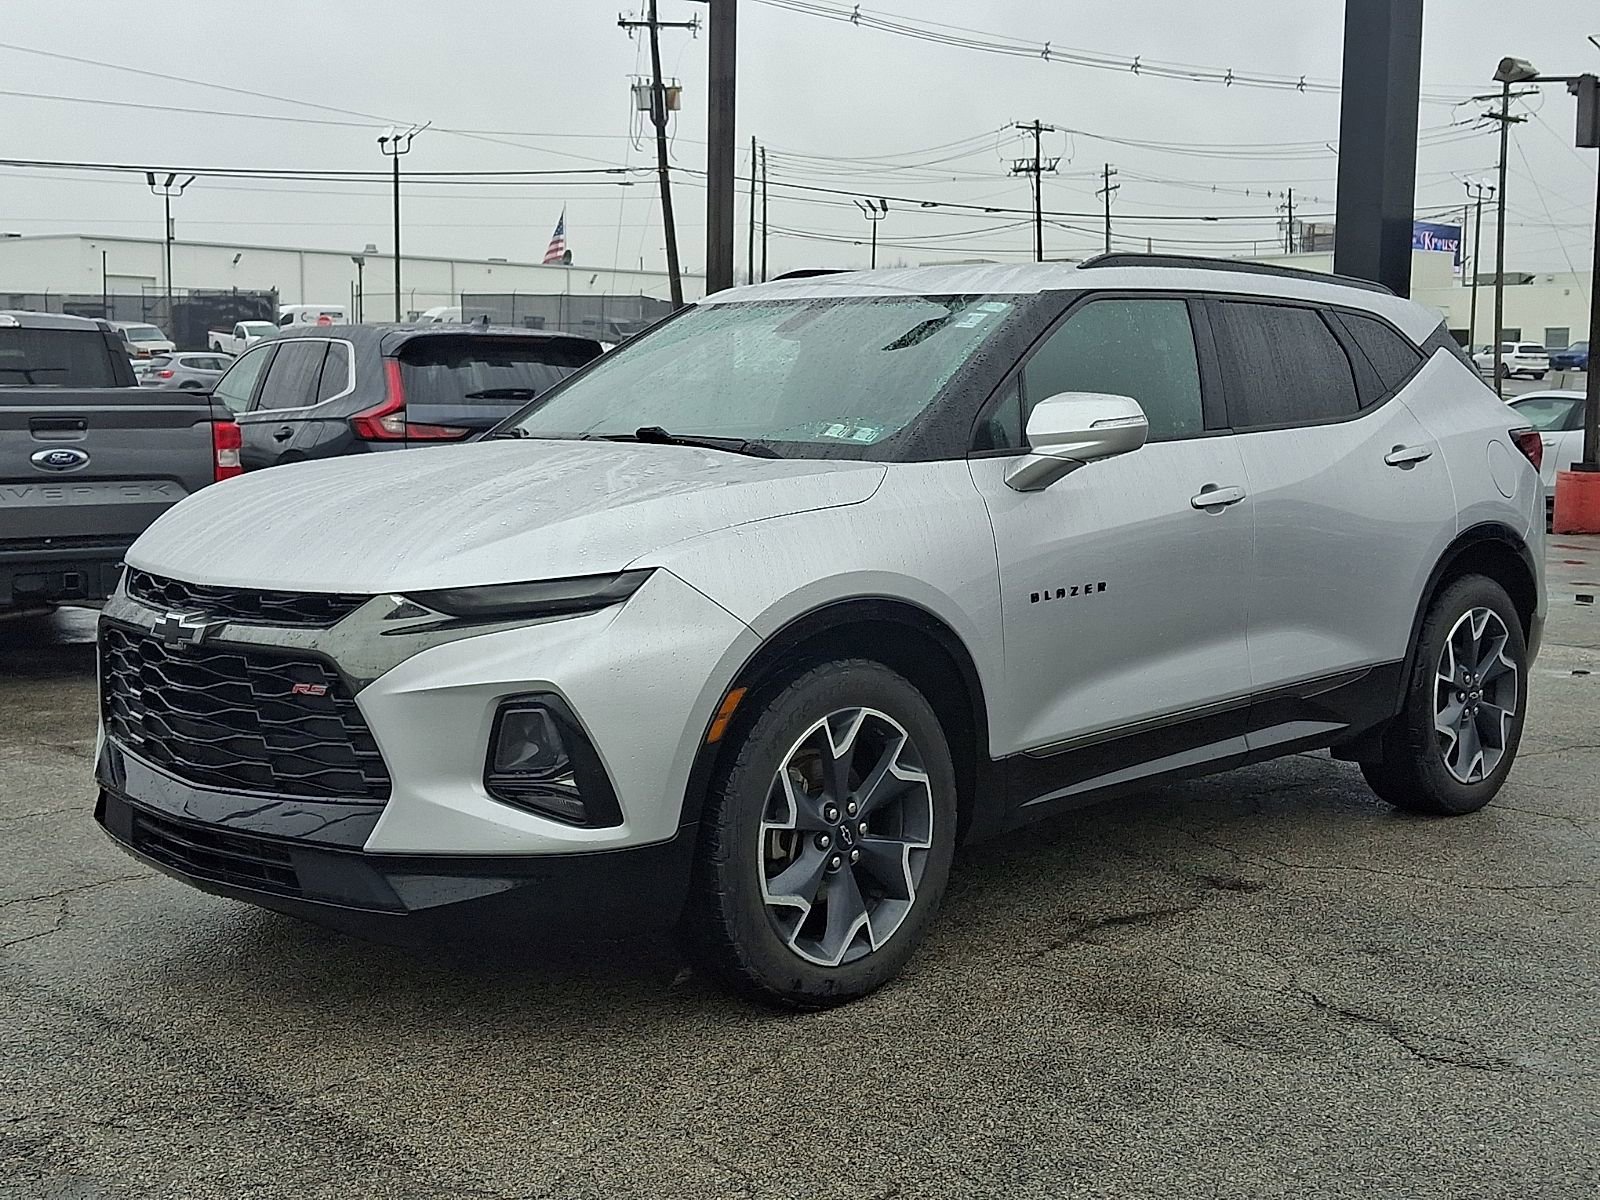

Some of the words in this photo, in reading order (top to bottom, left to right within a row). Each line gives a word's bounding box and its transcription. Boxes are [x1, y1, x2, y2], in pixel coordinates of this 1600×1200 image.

[50, 453, 74, 463] Ford
[0, 485, 170, 500] VERICK
[1030, 582, 1107, 603] BLAZER
[292, 683, 328, 696] RS
